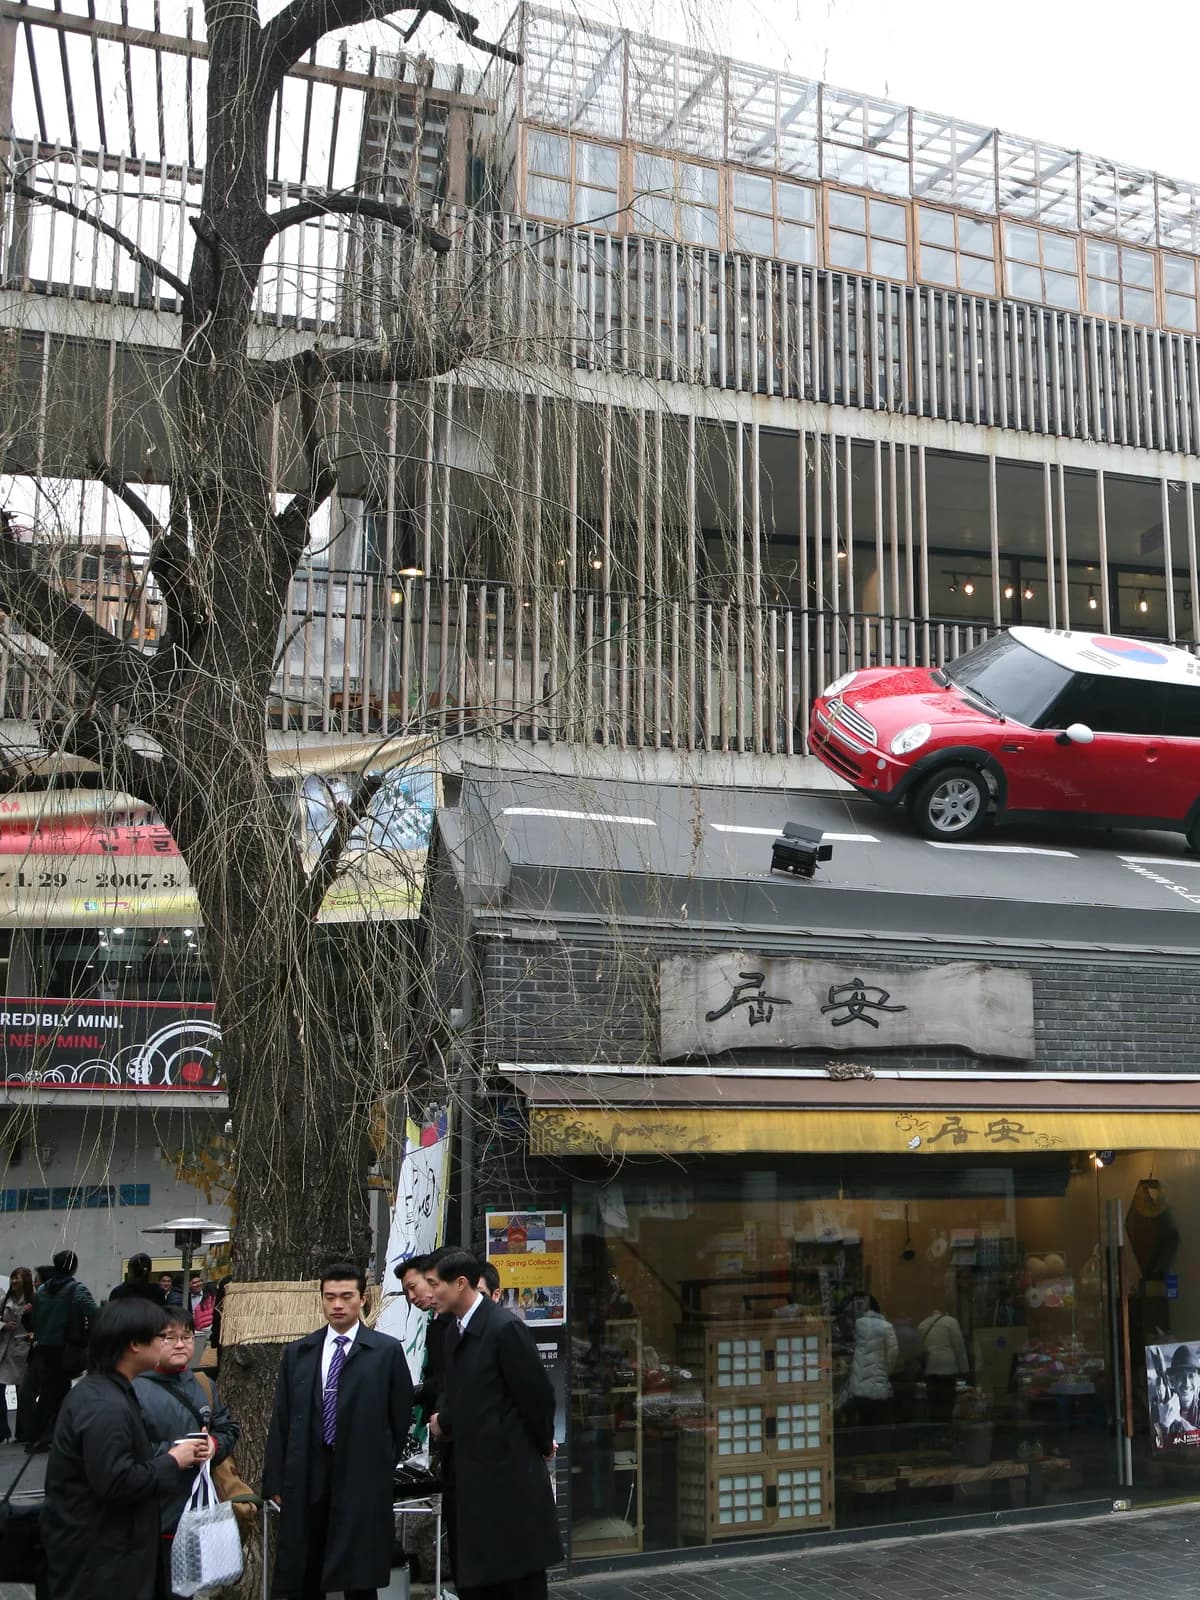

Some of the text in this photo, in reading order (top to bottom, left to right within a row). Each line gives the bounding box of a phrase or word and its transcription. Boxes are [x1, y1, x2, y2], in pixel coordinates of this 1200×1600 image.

[705, 971, 907, 1029] 居安
[77, 1014, 124, 1028] MINI.
[9, 1034, 54, 1047] NEW
[926, 1116, 1035, 1146] 居安
[506, 1260, 527, 1268] Spring
[528, 1257, 560, 1266] Collection
